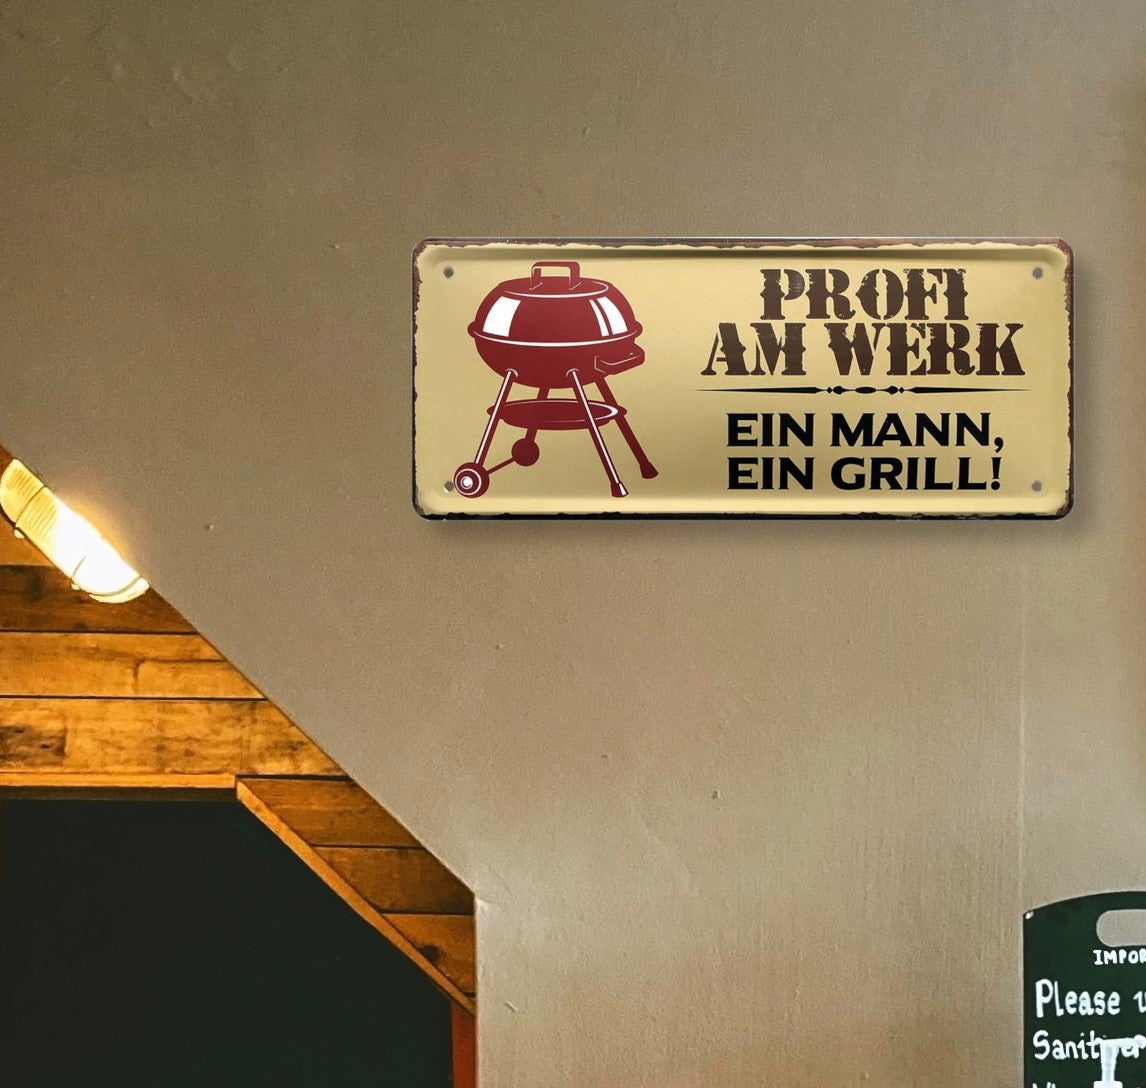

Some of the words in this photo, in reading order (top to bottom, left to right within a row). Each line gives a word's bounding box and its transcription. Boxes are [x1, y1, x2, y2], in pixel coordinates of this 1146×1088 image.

[759, 268, 968, 321] PROFI
[700, 322, 806, 377] AM
[822, 322, 1026, 377] WERK
[726, 412, 816, 448] EIN
[829, 412, 1005, 453] MANN,
[726, 456, 816, 491] EIN
[829, 456, 1002, 491] GRILL!
[1035, 978, 1122, 1019] Please
